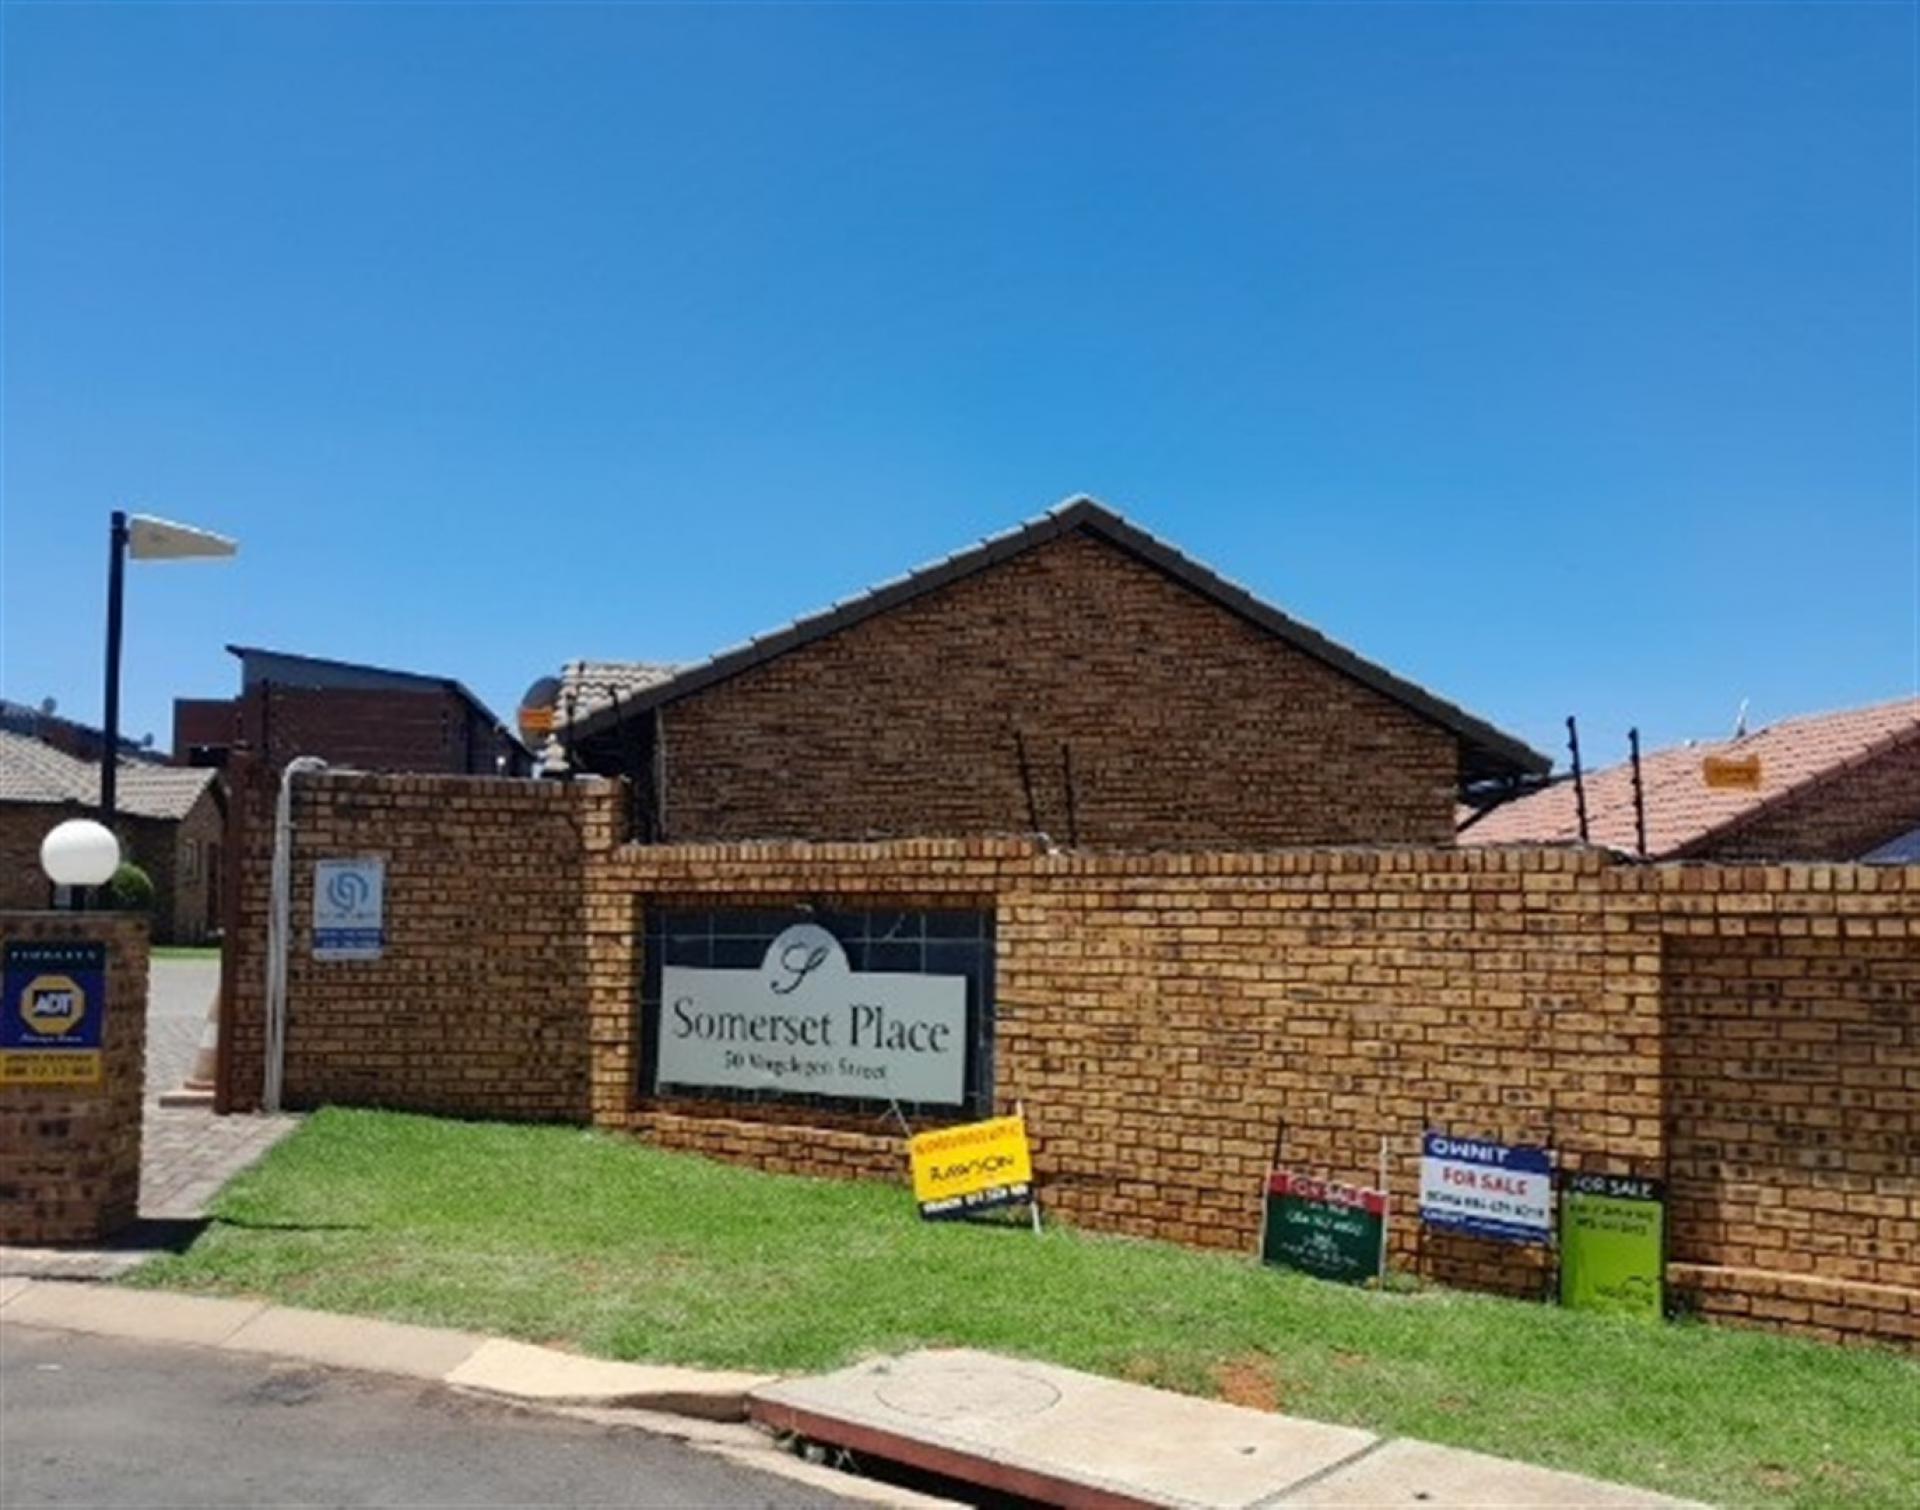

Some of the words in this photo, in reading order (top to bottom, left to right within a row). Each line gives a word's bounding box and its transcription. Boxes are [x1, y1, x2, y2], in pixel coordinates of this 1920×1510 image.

[36, 992, 70, 1014] ADT
[673, 997, 832, 1046] Somerset
[850, 1003, 949, 1052] Place
[1430, 1139, 1510, 1163] OWNIT
[1443, 1166, 1476, 1188] FOR
[1481, 1173, 1527, 1196] SALE
